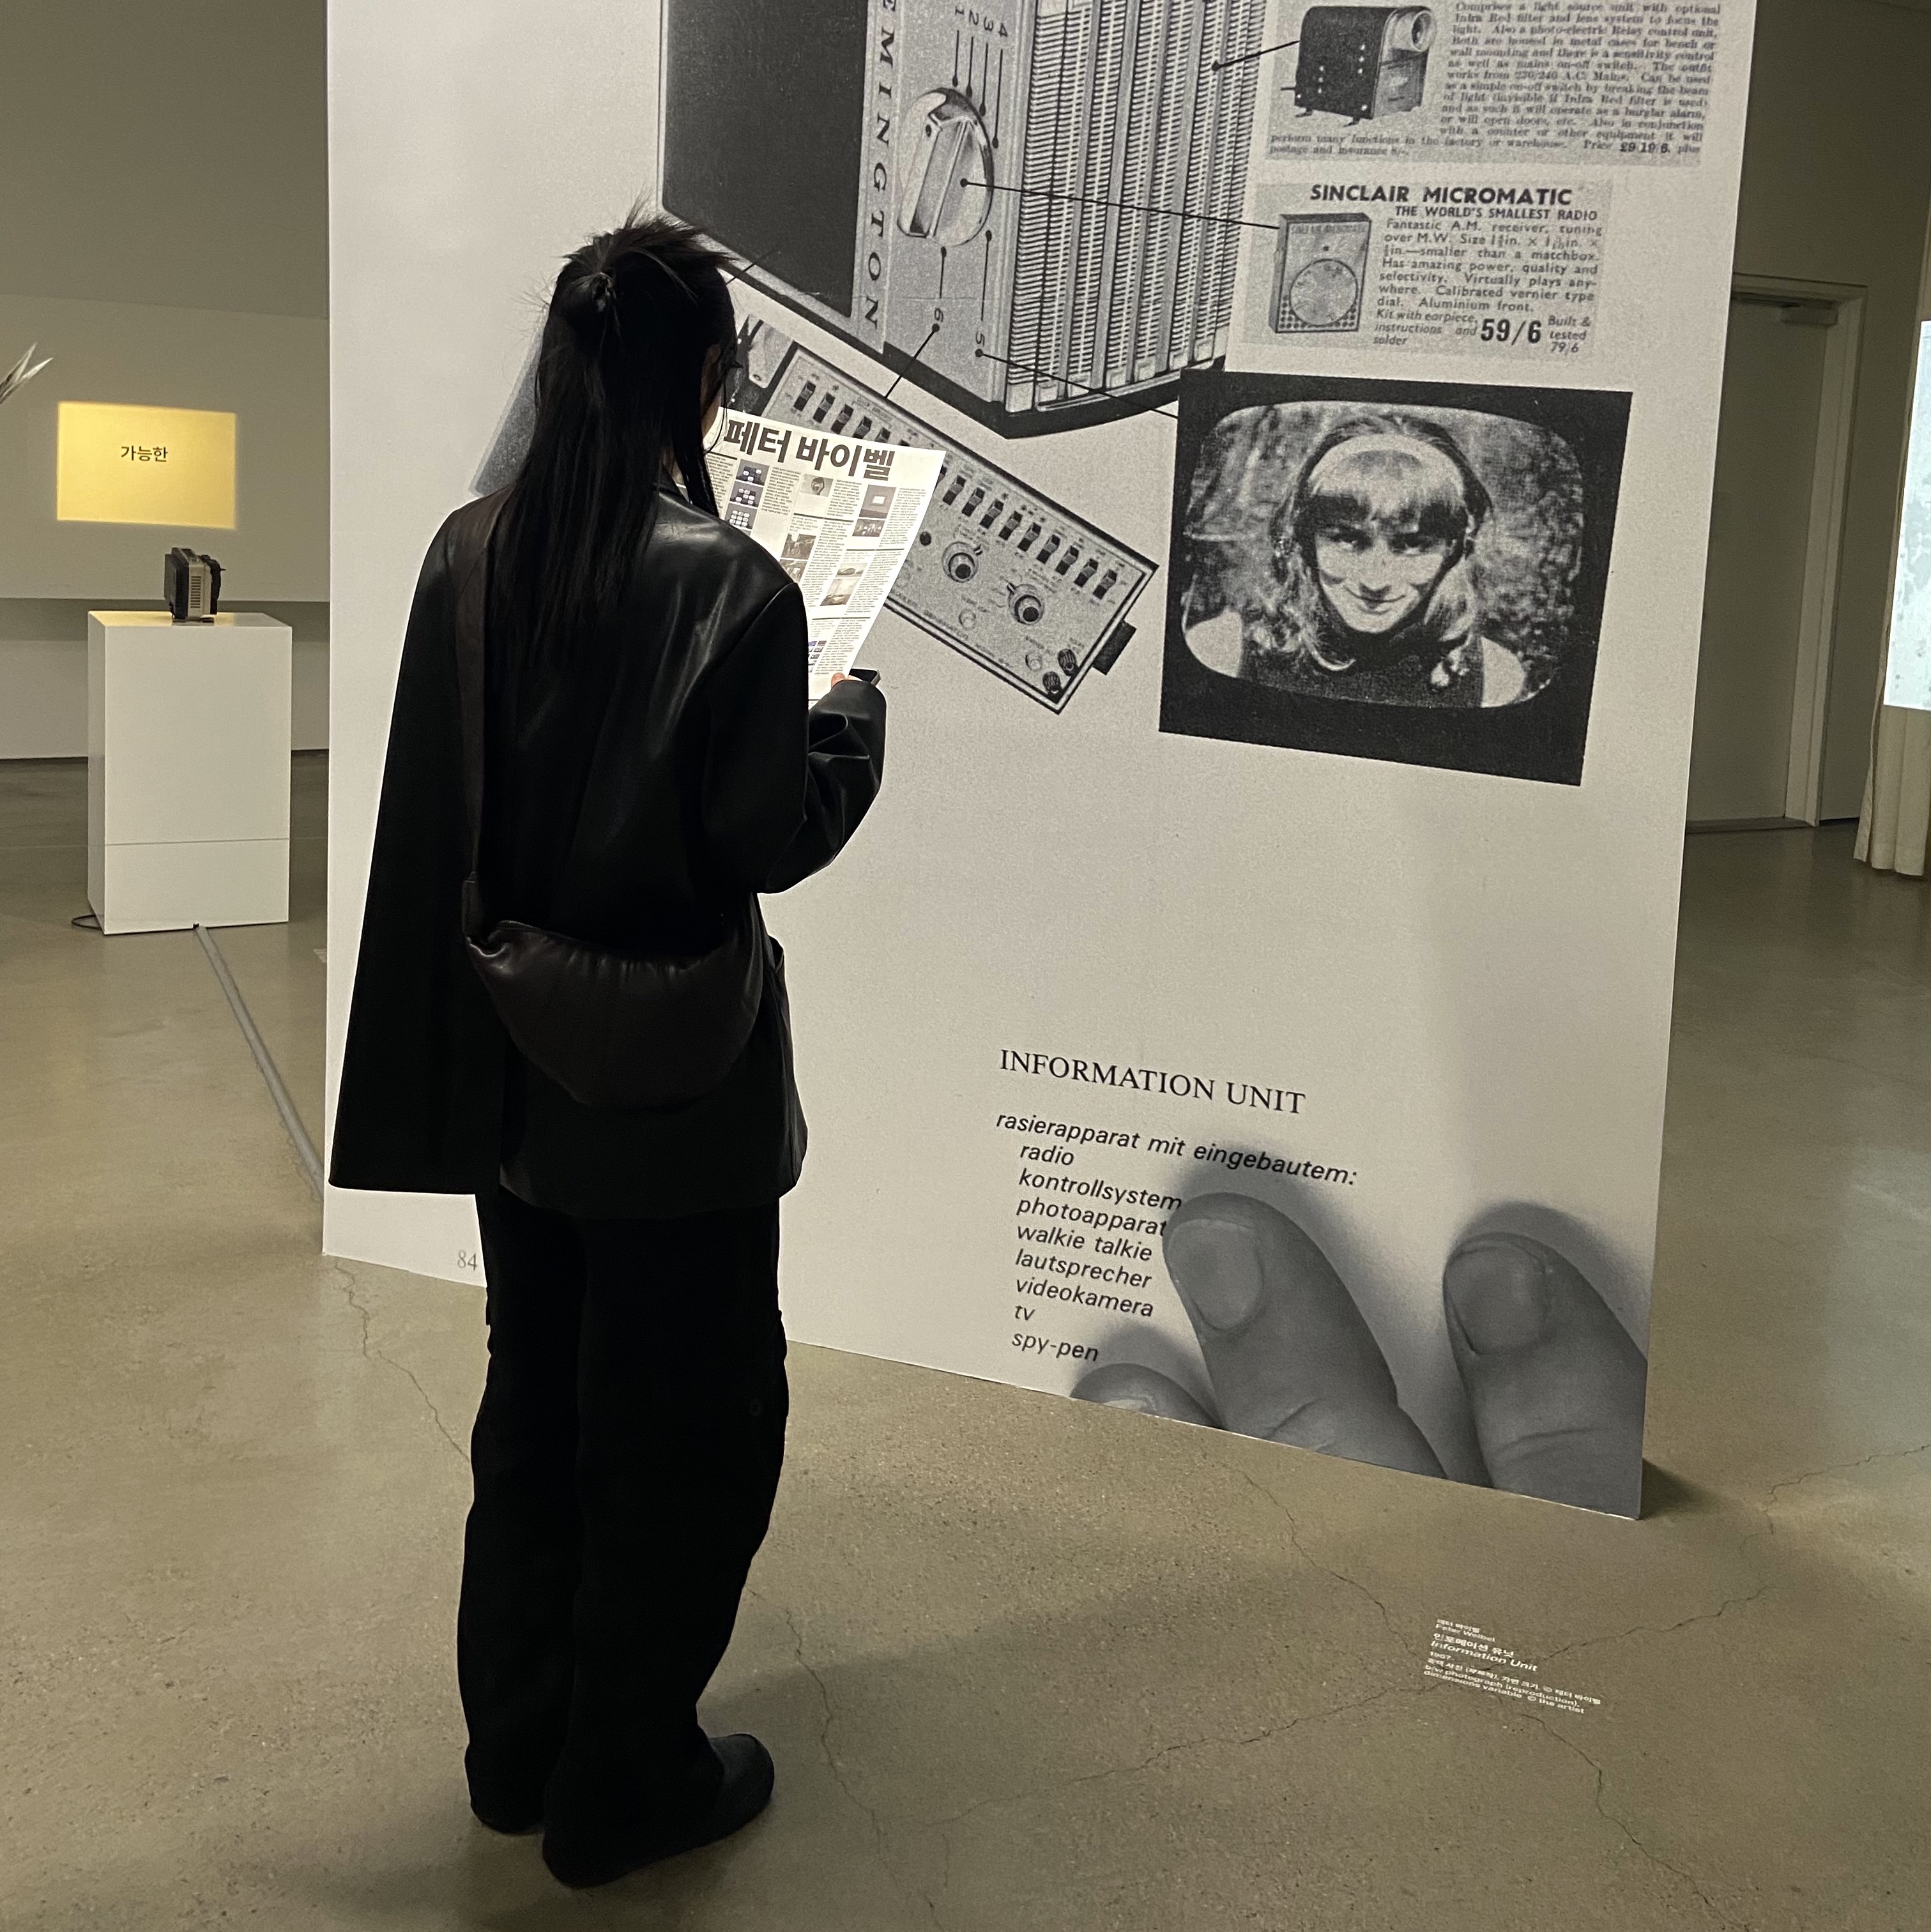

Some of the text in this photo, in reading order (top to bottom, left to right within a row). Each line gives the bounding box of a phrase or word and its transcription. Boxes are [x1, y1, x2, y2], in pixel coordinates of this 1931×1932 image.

[955, 6, 964, 15] 1
[1643, 4, 1667, 12] with
[969, 10, 979, 26] 2
[984, 16, 994, 32] 3
[998, 22, 1008, 38] 4
[1309, 184, 1573, 206] SINCLAIR MICROMATIC
[1395, 206, 1597, 220] THE WORLD'S SMALLEST RADIO
[1387, 218, 1441, 230] Fantastic
[1451, 220, 1481, 231] A.M.
[1559, 225, 1603, 237] tuning
[1384, 234, 1413, 242] over
[1460, 234, 1486, 244] Size
[1477, 247, 1506, 258] than
[1515, 251, 1521, 259] a
[1382, 257, 1405, 268] Has
[1410, 261, 1462, 272] amazing
[1522, 262, 1567, 276] quality
[1573, 264, 1598, 275] and
[1380, 271, 1447, 284] selectivity.
[1464, 272, 1521, 286] Virtually
[1529, 275, 1562, 288] plays
[1377, 296, 1403, 307] dial.
[1418, 297, 1490, 310] Aluminium
[1436, 285, 1503, 297] Calibrated
[1510, 289, 1558, 300] vernier
[1565, 292, 1594, 303] type
[934, 307, 943, 323] 6
[1377, 308, 1394, 319] Kit
[1397, 309, 1422, 320] with
[1548, 315, 1591, 327] Built &
[975, 331, 985, 346] 5
[1375, 323, 1477, 336] instructions and
[1481, 318, 1541, 346] 59/6
[1550, 330, 1587, 340] tested
[1373, 334, 1407, 346] solder
[121, 445, 168, 462] 가능한
[724, 419, 896, 482] 페터 바이벨
[1000, 1049, 1306, 1114] INFORMATION UNIT
[996, 1113, 1357, 1186] rasierapparat mit eingebautem:
[1020, 1143, 1075, 1166] radio
[1019, 1169, 1182, 1210] kontrollsystem
[1016, 1196, 1167, 1237] photoapparat
[1017, 1224, 1152, 1262] walkie talkie
[457, 1250, 478, 1271] 84
[1016, 1249, 1152, 1289] lautsprecher
[1016, 1278, 1154, 1318] videokamera
[1014, 1304, 1035, 1321] tv
[1012, 1330, 1099, 1362] spy-pen
[1433, 1633, 1514, 1658] 인포메이션 유닛
[1431, 1640, 1538, 1671] Information Unit
[1445, 1670, 1503, 1688] photograph
[1424, 1670, 1481, 1687] dimensions
[1483, 1685, 1522, 1698] variable
[1539, 1698, 1555, 1707] the
[1557, 1703, 1585, 1714] artist
